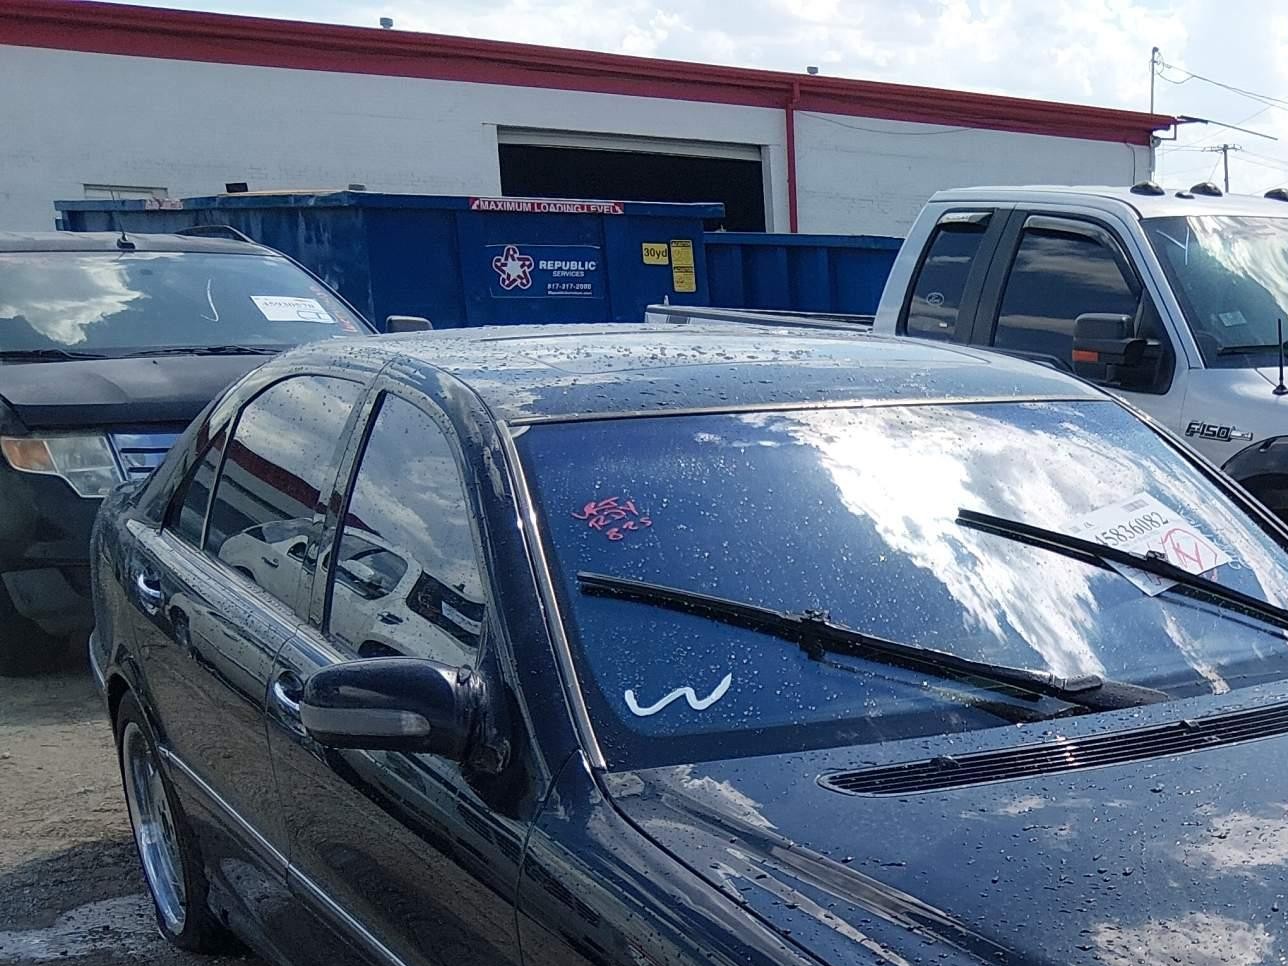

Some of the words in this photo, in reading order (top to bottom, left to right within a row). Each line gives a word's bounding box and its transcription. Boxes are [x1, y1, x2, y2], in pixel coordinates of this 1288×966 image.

[480, 201, 531, 212] MAXIMUM
[534, 203, 581, 213] LOADING
[644, 247, 667, 260] 30yd
[539, 260, 597, 271] REPUBLIC
[552, 270, 585, 278] SERVICES
